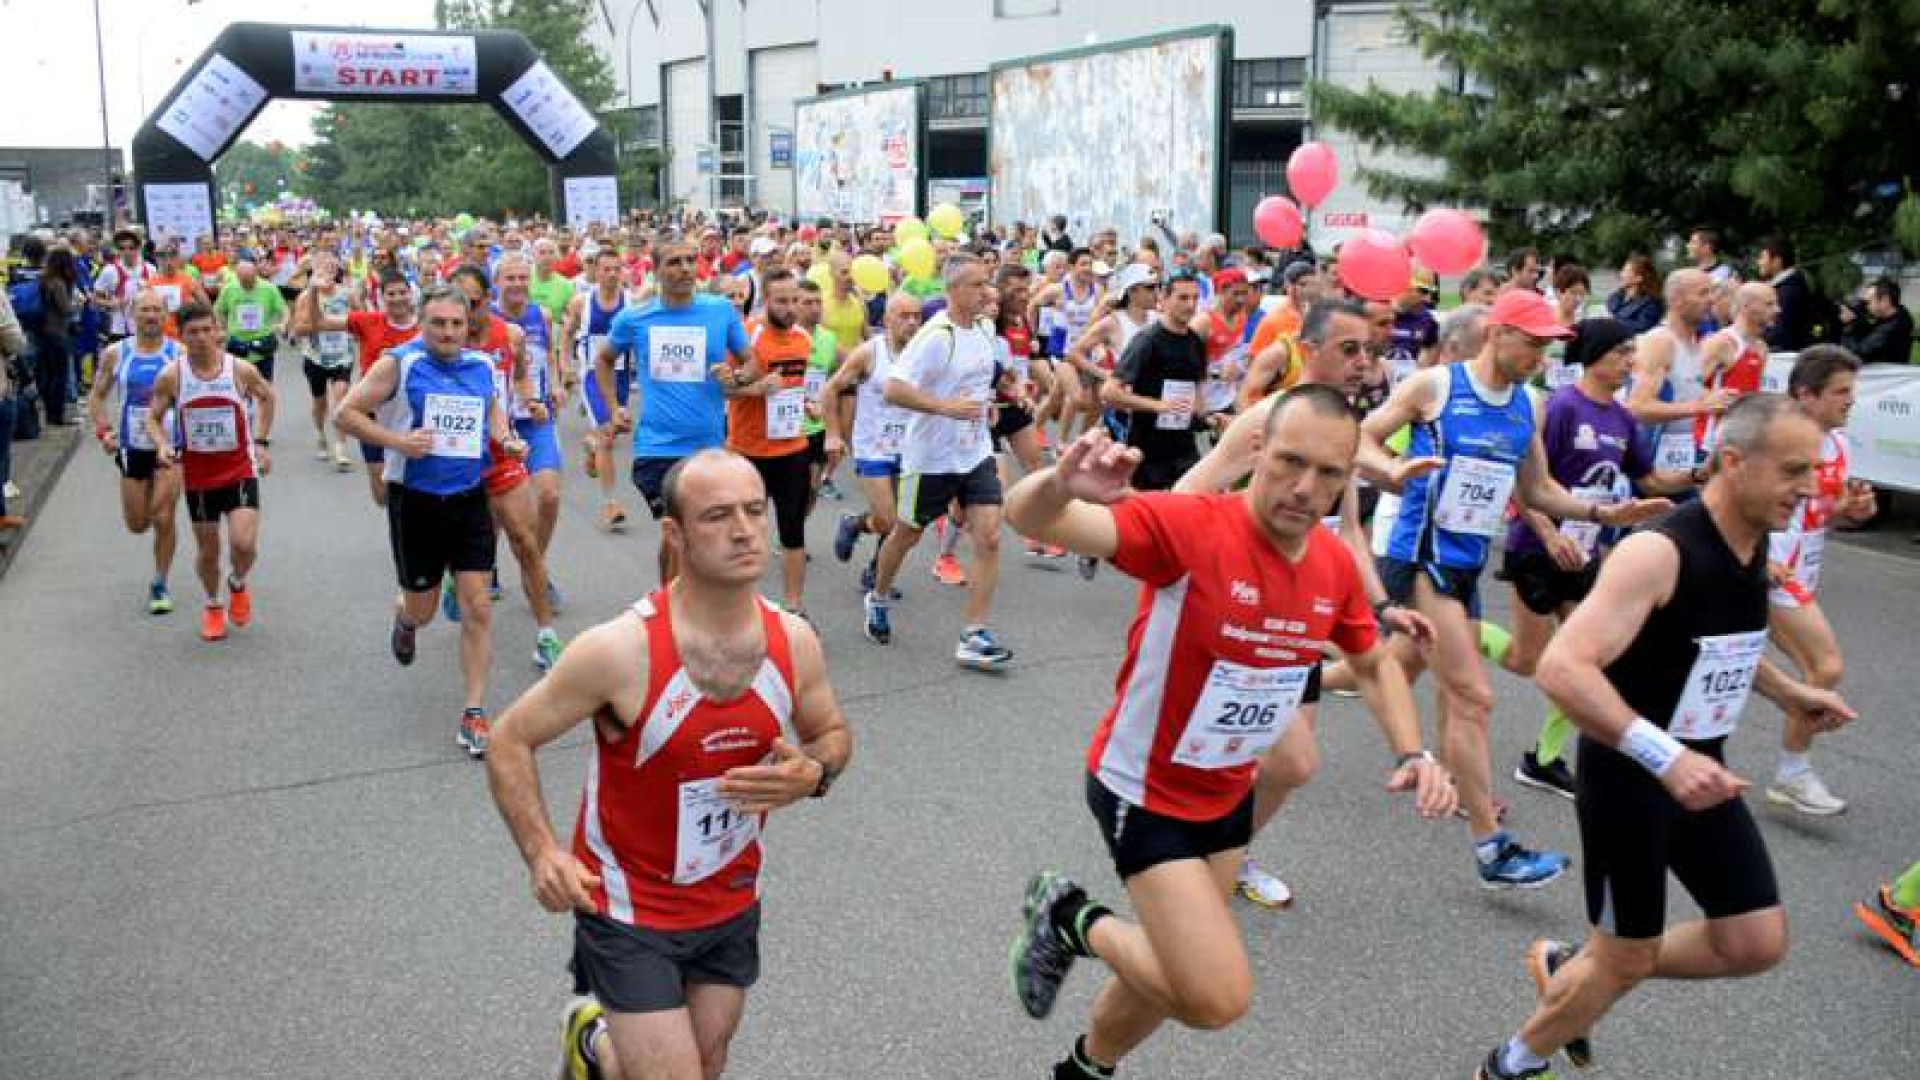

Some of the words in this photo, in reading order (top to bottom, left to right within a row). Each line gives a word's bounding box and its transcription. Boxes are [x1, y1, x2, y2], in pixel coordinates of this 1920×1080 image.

[336, 65, 439, 87] START
[661, 343, 695, 359] 500
[431, 413, 476, 431] 1022
[1458, 481, 1496, 501] 704
[1216, 701, 1280, 726] 206
